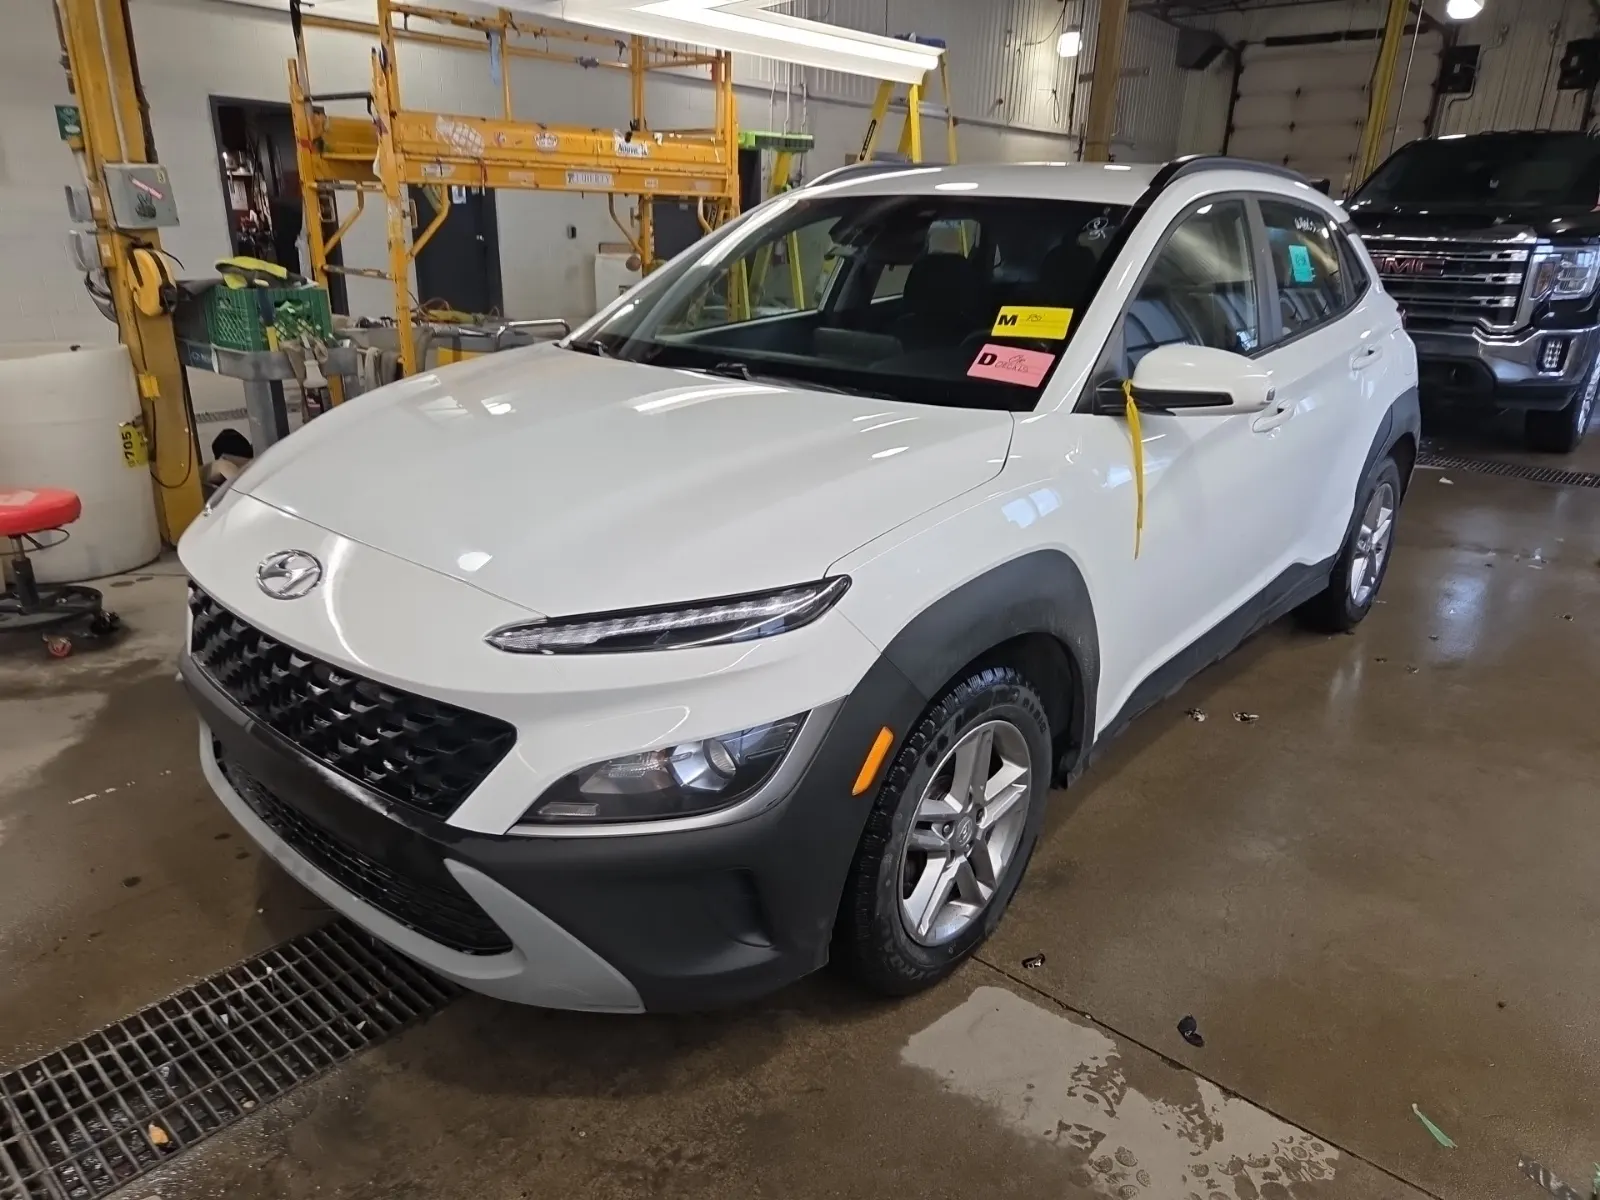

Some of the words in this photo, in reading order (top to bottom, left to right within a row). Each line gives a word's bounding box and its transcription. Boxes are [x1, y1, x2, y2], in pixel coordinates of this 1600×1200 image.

[997, 314, 1018, 326] M
[977, 352, 997, 366] D
[121, 431, 135, 460] 705
